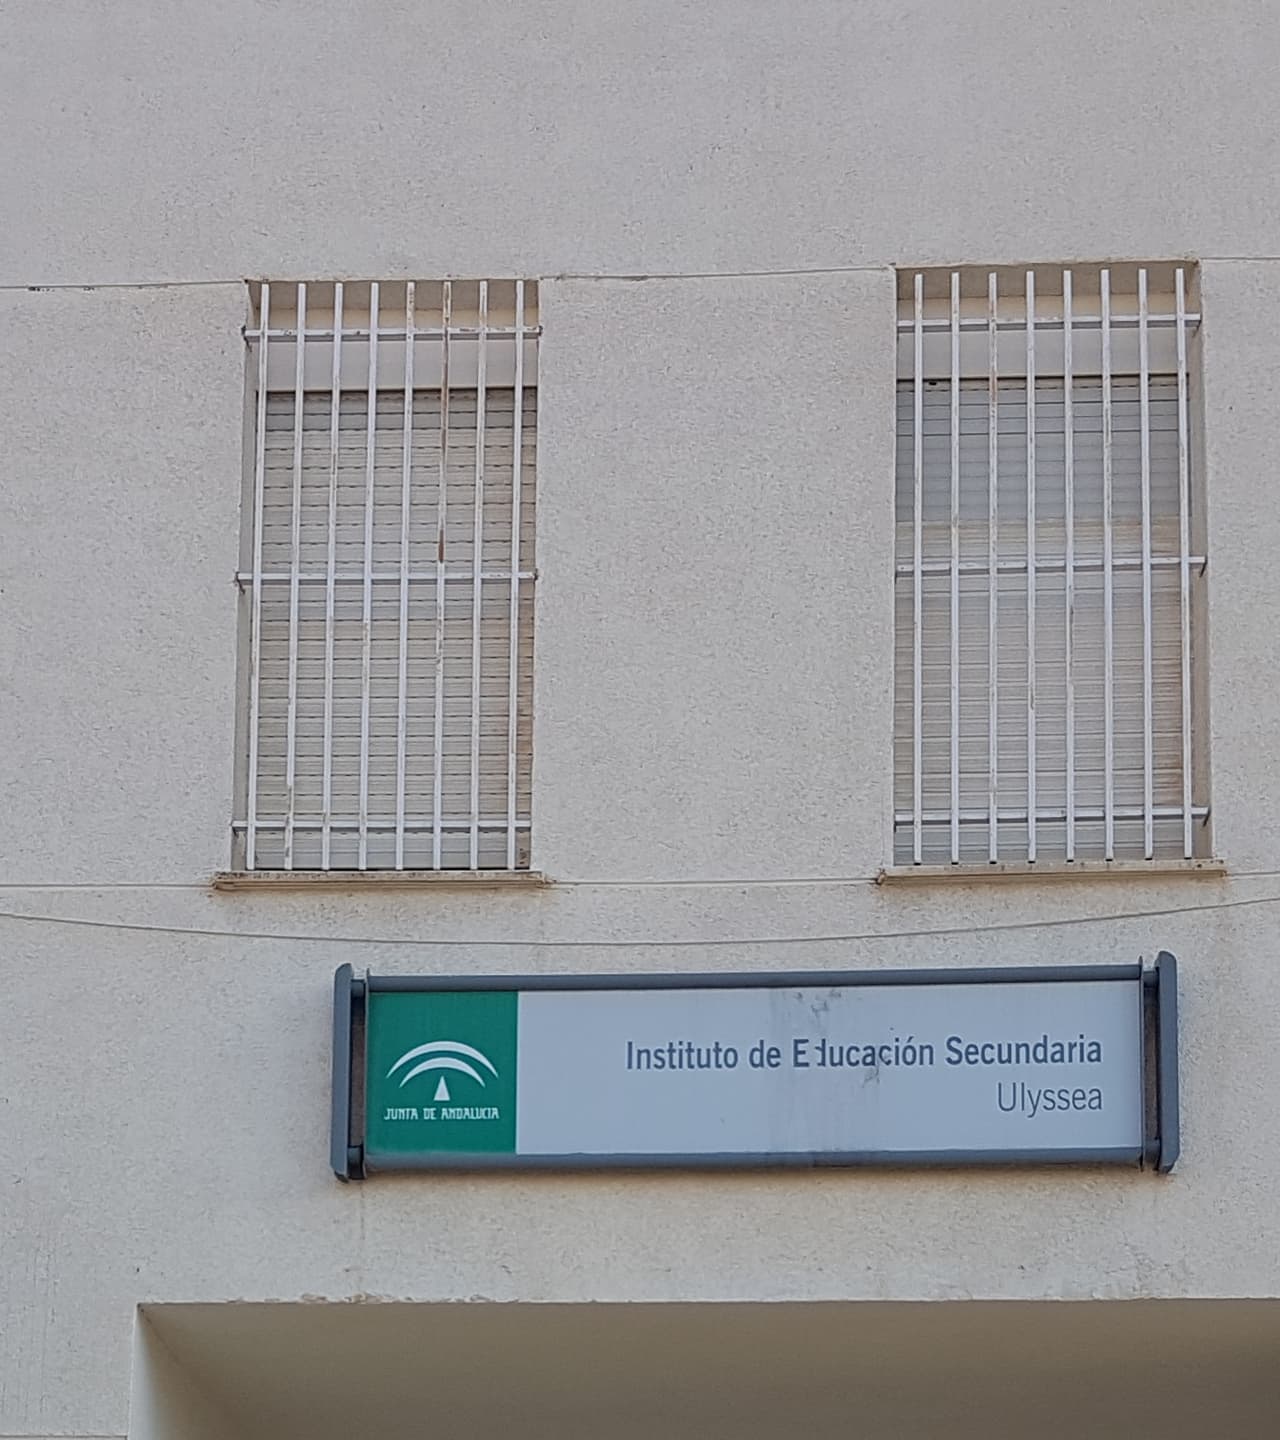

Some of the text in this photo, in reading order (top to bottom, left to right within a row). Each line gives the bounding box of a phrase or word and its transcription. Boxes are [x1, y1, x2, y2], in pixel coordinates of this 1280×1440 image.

[626, 1040, 739, 1070] Instituto
[748, 1039, 782, 1069] de
[945, 1034, 1102, 1066] Secundaria
[383, 1107, 500, 1120] JUNTA DE ANDALUCIA
[997, 1081, 1103, 1119] Ulyssea
